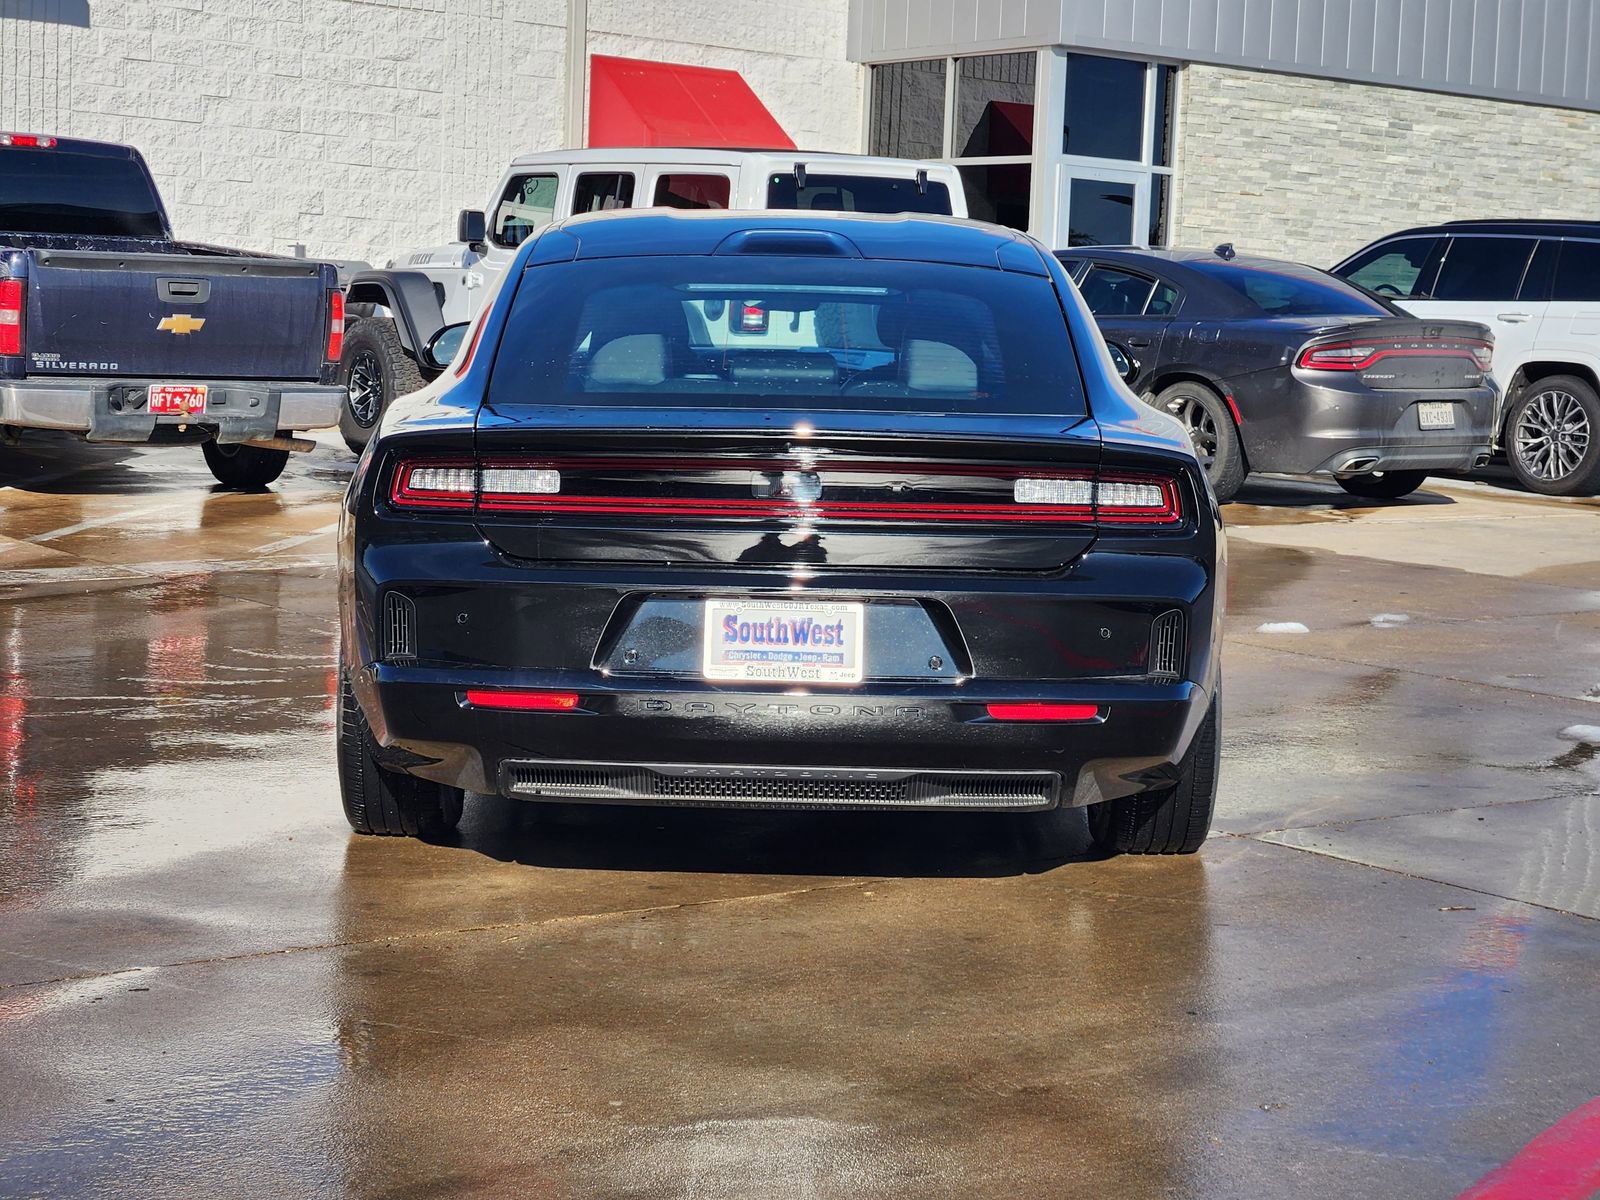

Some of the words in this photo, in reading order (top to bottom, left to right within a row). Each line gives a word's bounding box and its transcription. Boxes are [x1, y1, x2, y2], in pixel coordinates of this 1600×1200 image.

[35, 361, 118, 370] SILVERADO
[151, 393, 173, 407] RFY
[722, 614, 844, 647] SouthWest
[728, 651, 761, 661] Chrysler
[767, 651, 793, 662] Dodge
[798, 652, 818, 663] Jeep
[822, 653, 840, 662] Ram
[746, 665, 821, 679] SouthWest
[637, 698, 926, 718] DAYTONA
